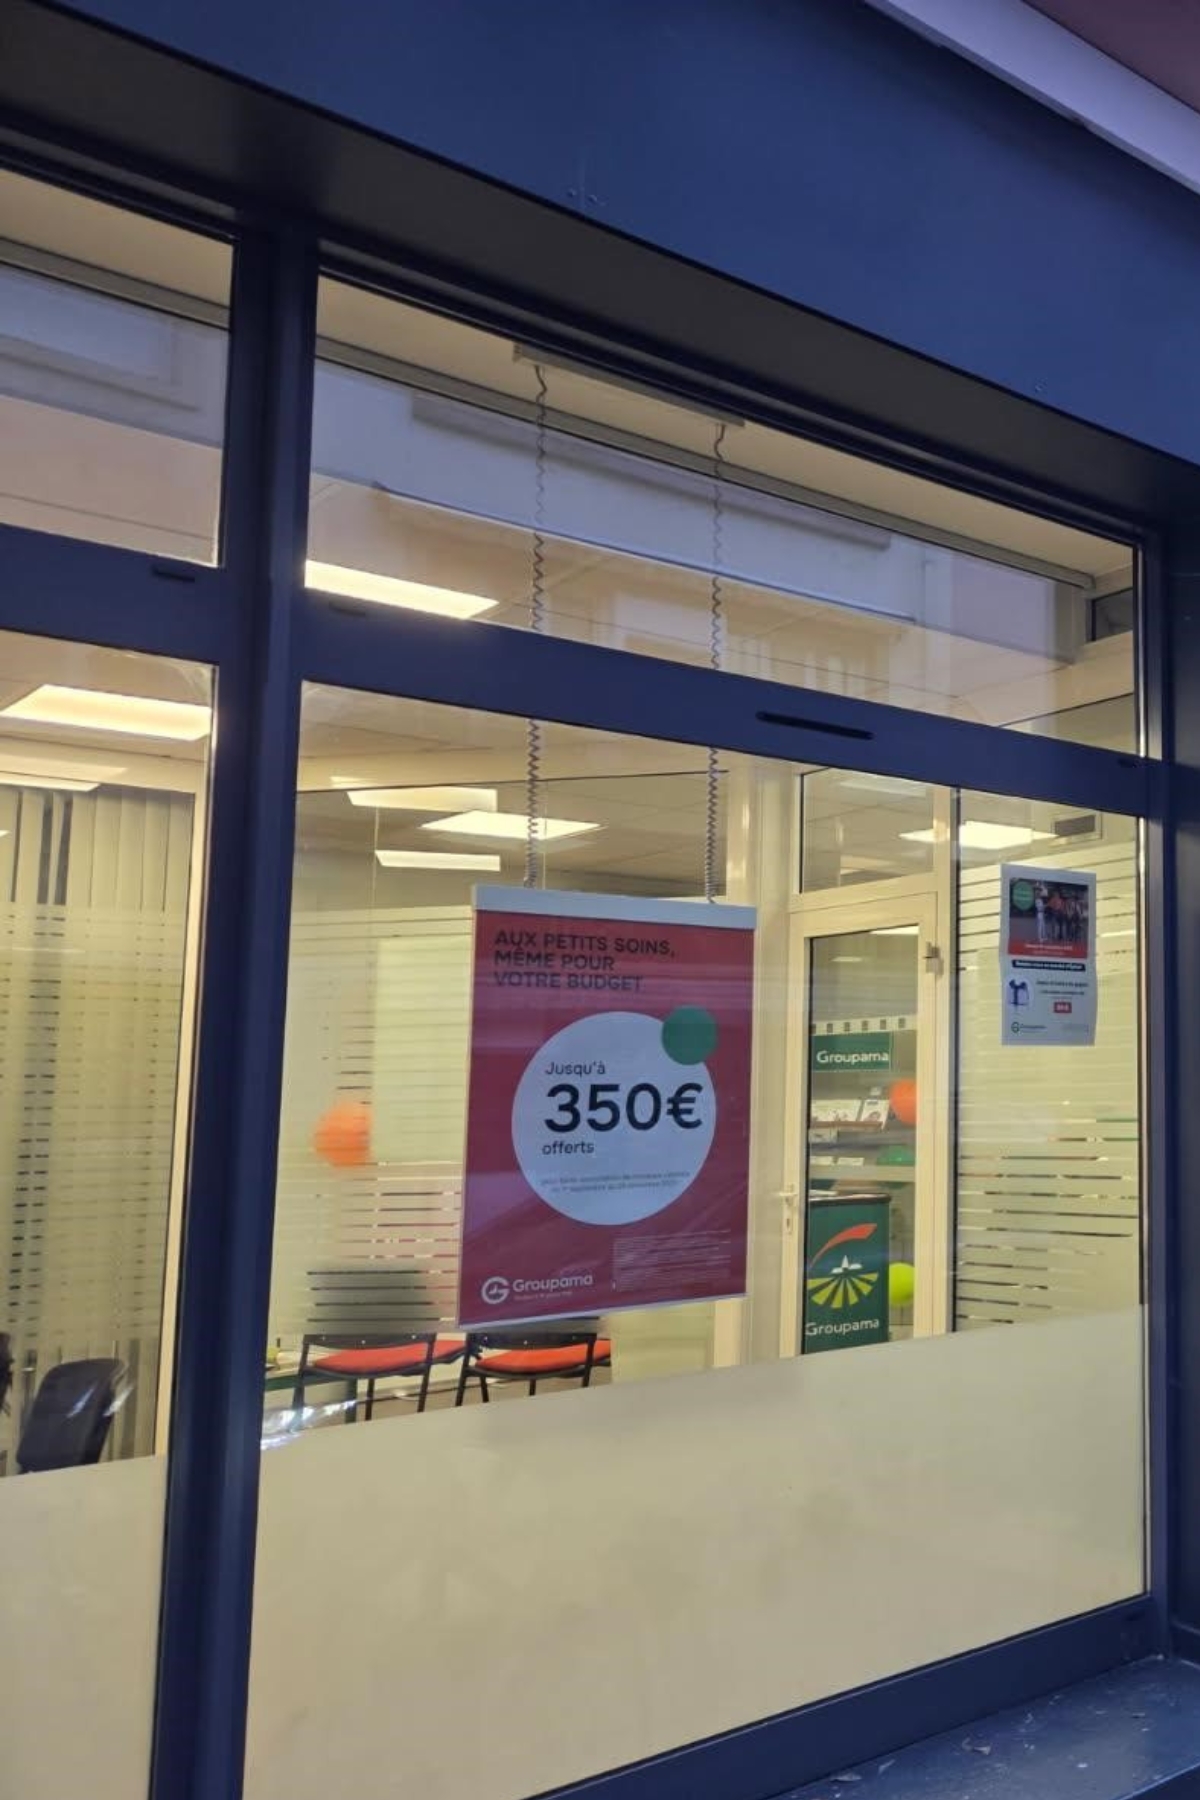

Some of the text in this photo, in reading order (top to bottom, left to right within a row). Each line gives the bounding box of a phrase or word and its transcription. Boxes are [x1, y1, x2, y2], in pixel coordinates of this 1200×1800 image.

[494, 930, 675, 958] AUX PETITS SOINS,
[494, 946, 615, 971] MÊME POUR
[494, 971, 643, 992] VOTRE BUDGET
[815, 1049, 890, 1066] Groupama
[544, 1060, 606, 1078] Jusqu'à
[544, 1082, 704, 1133] 350€
[541, 1140, 595, 1156] offerts
[512, 1274, 594, 1293] Groupama
[804, 1318, 880, 1336] Groupama
